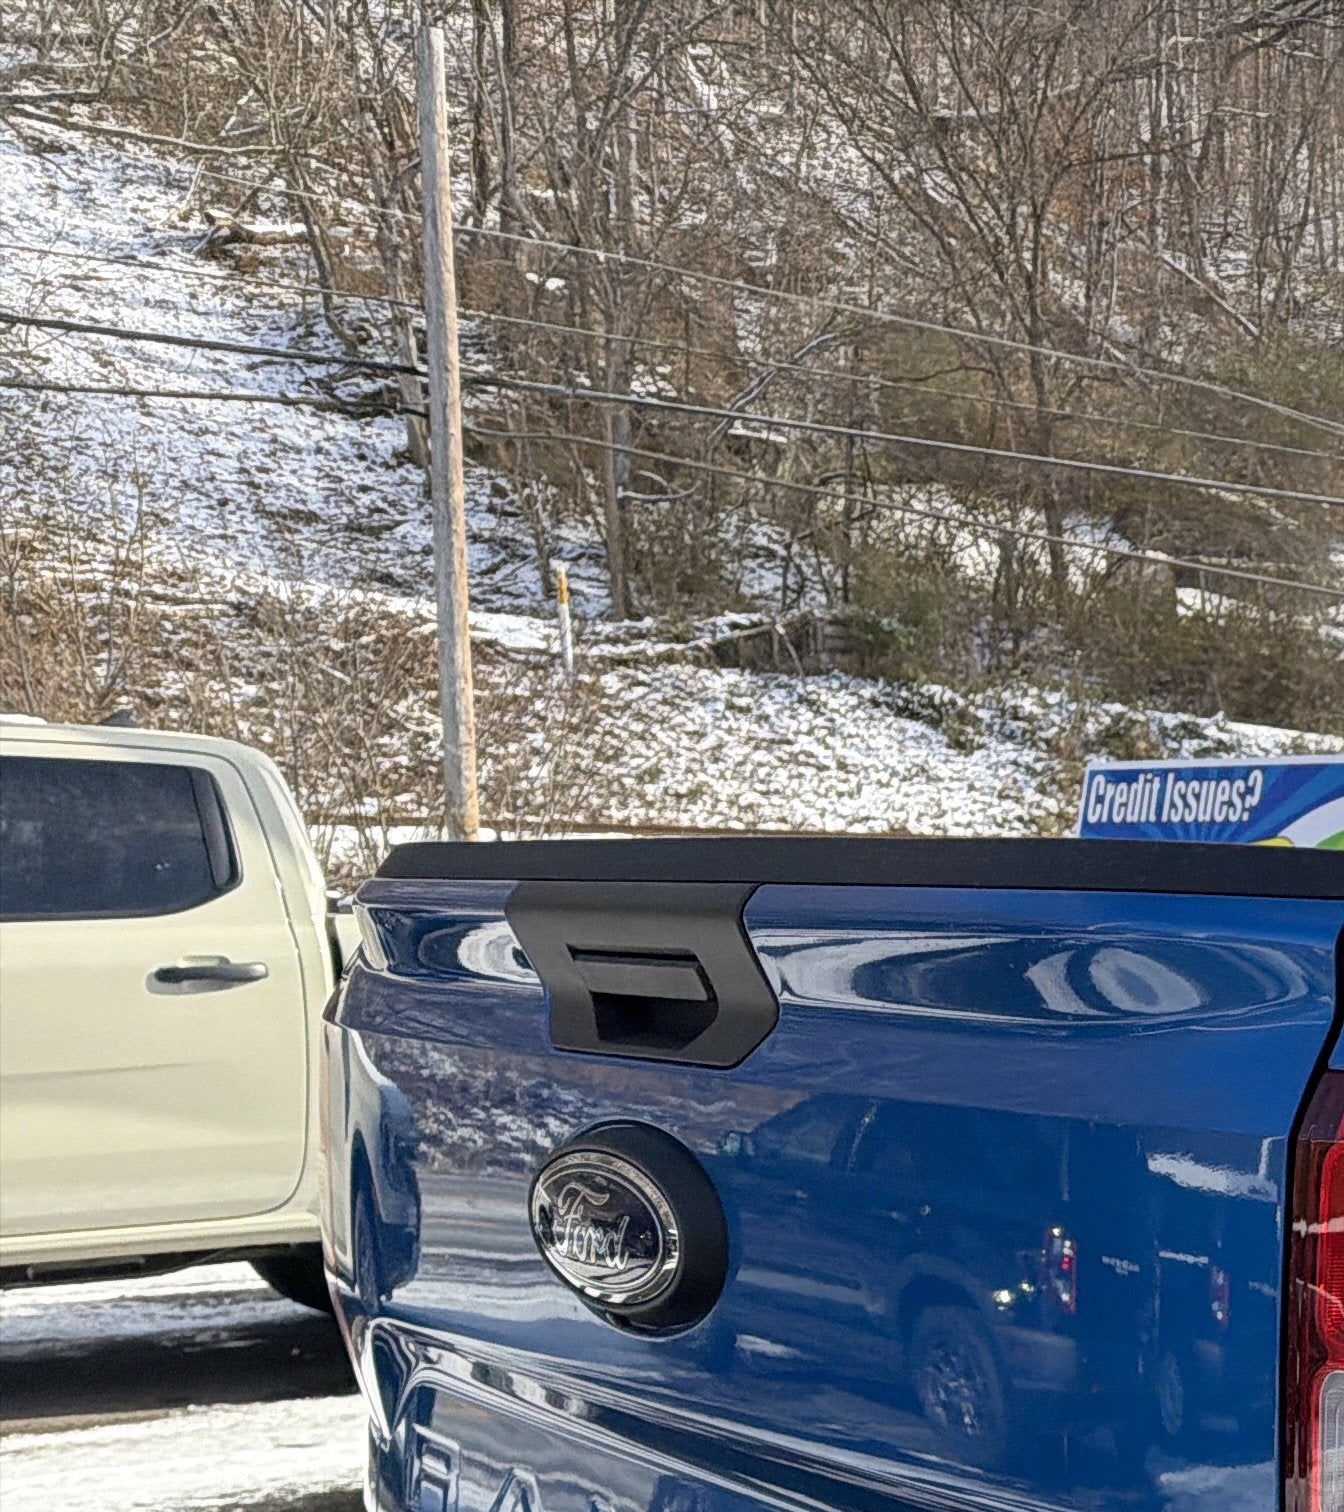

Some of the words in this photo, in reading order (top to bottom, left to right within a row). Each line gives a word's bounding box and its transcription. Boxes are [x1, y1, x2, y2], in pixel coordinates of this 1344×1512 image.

[1087, 772, 1160, 824] Credit
[1162, 769, 1264, 823] Issues?
[552, 1181, 630, 1271] Ford
